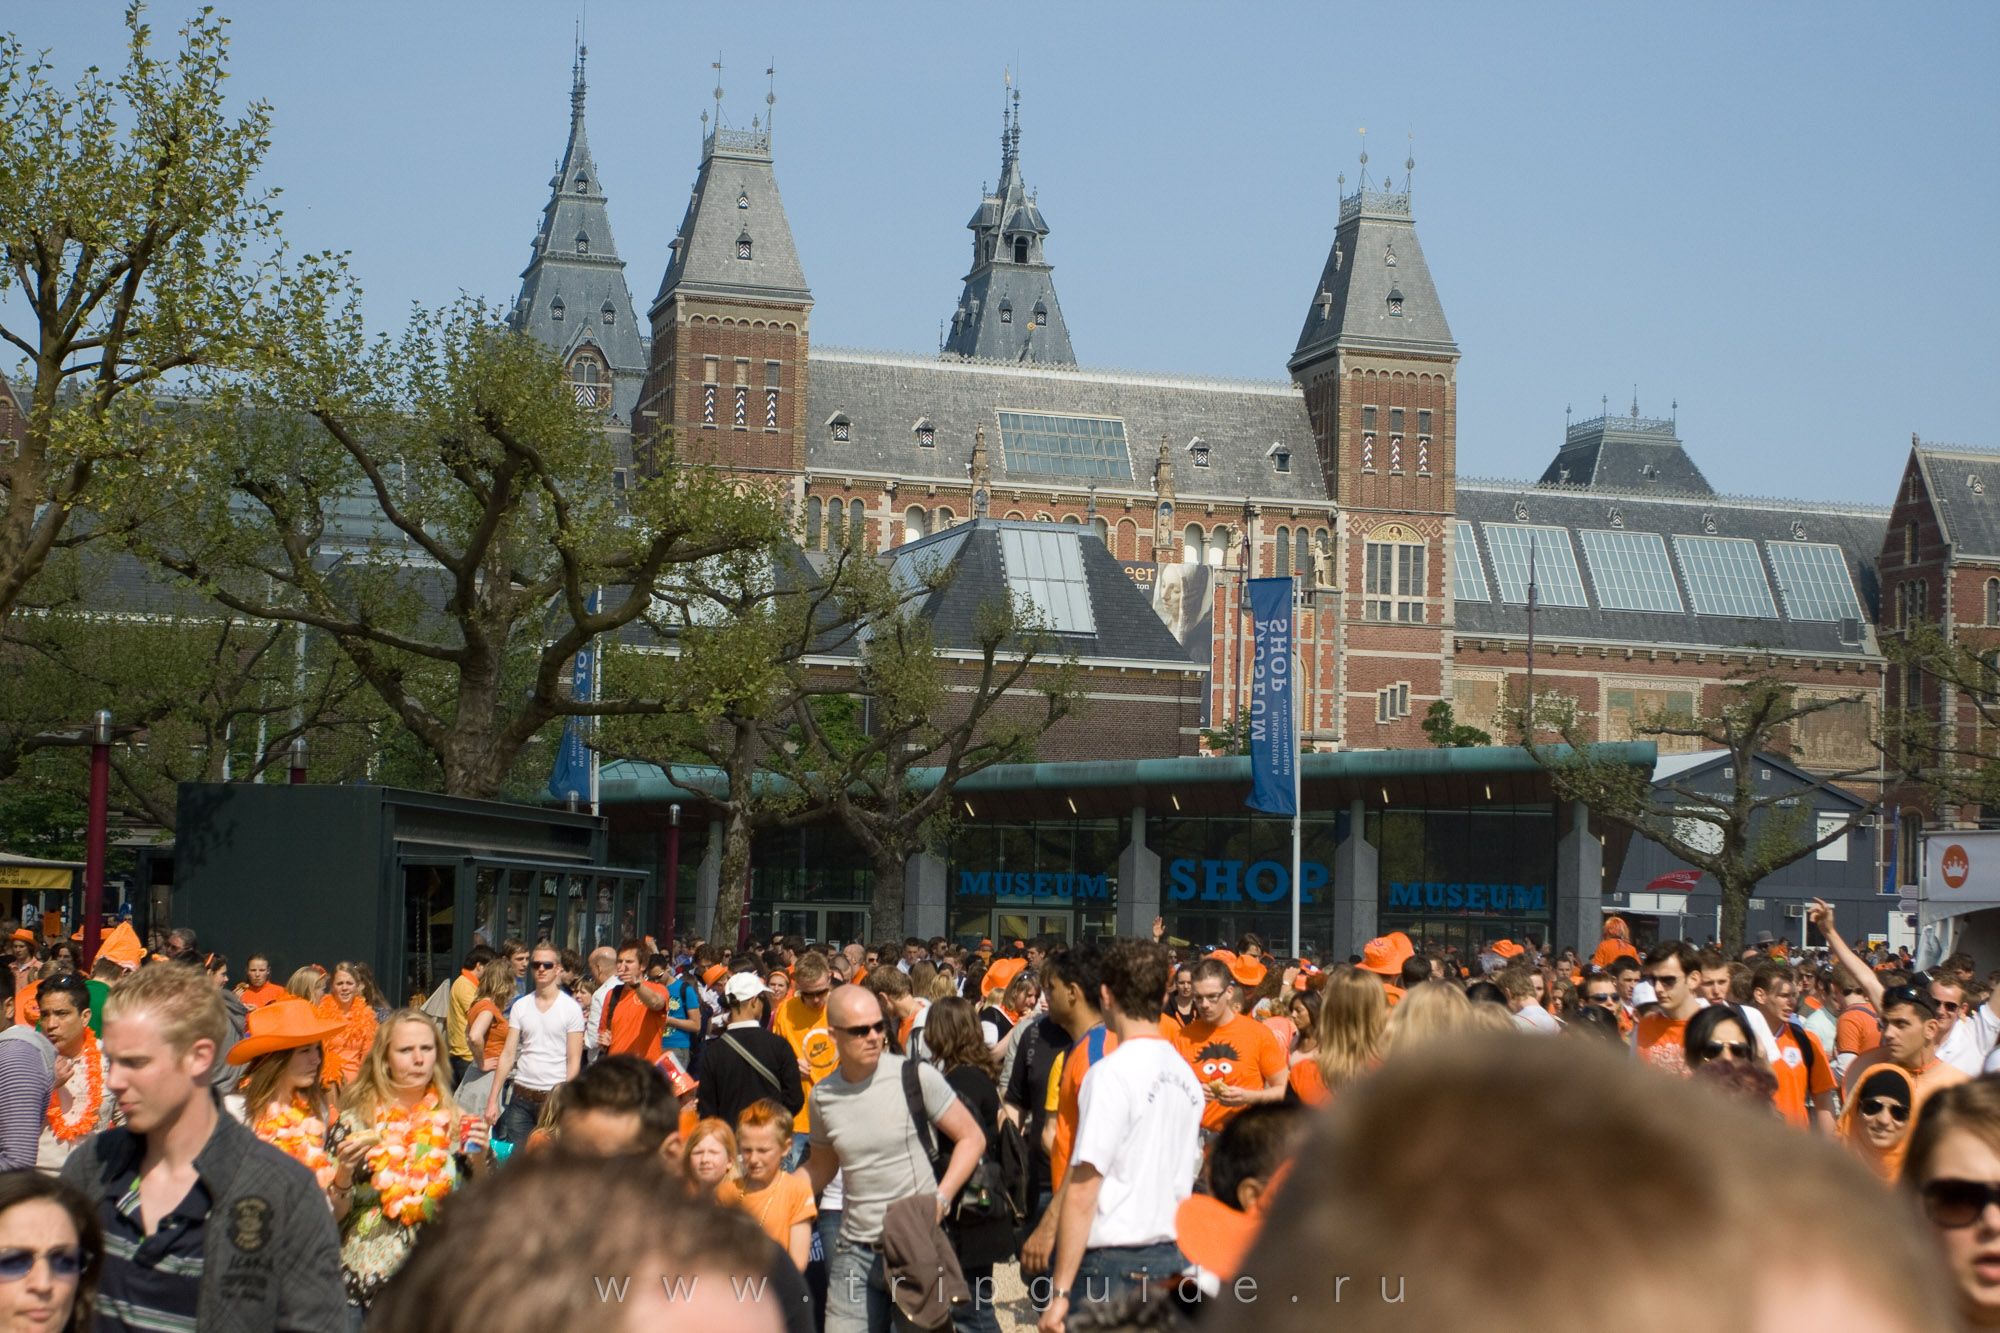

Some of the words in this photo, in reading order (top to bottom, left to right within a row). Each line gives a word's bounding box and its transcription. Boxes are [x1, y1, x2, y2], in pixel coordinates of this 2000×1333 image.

[958, 871, 1109, 899] MUSEUM
[1169, 858, 1329, 904] SHOP
[1389, 882, 1545, 909] MUSEUM
